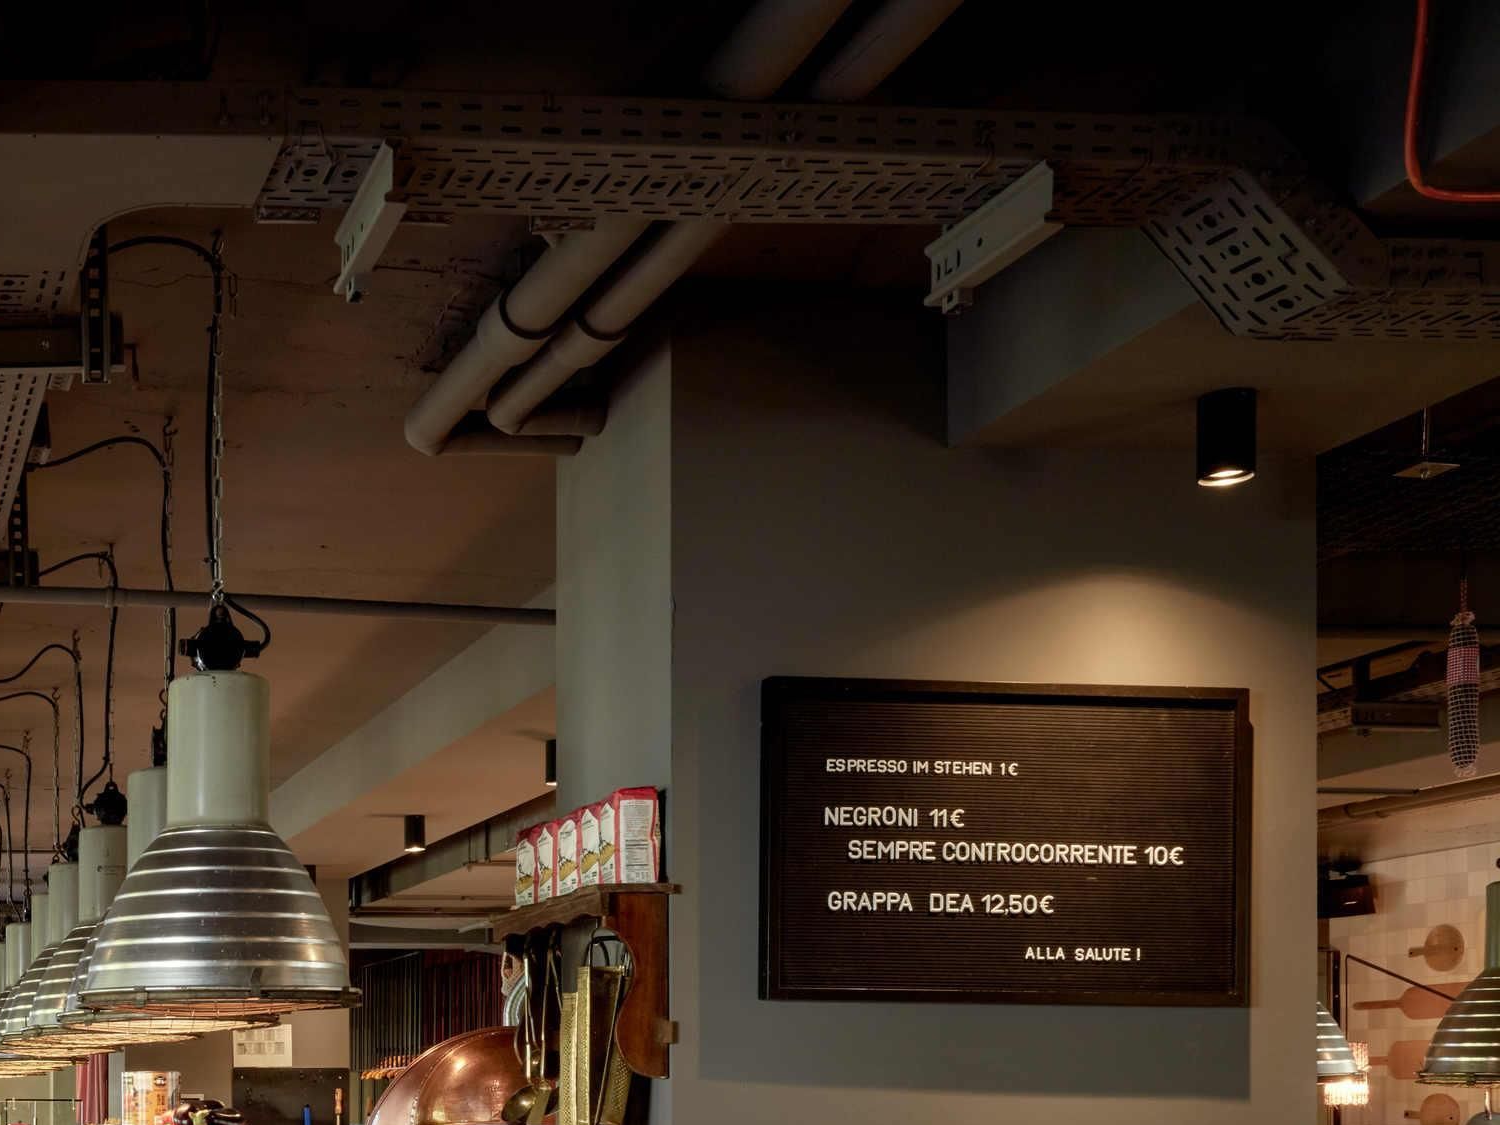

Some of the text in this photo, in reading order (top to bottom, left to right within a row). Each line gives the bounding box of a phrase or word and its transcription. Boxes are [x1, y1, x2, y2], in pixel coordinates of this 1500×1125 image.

[826, 758, 1019, 777] ESPRESSO IM STEHEN 1€
[824, 805, 965, 828] NEGRONI 11€
[848, 839, 1185, 867] SEMPRE CONTROCORRENTE 10€
[827, 890, 1055, 916] GRAPPA DEA 12,50€
[1024, 946, 1066, 961] ALLA
